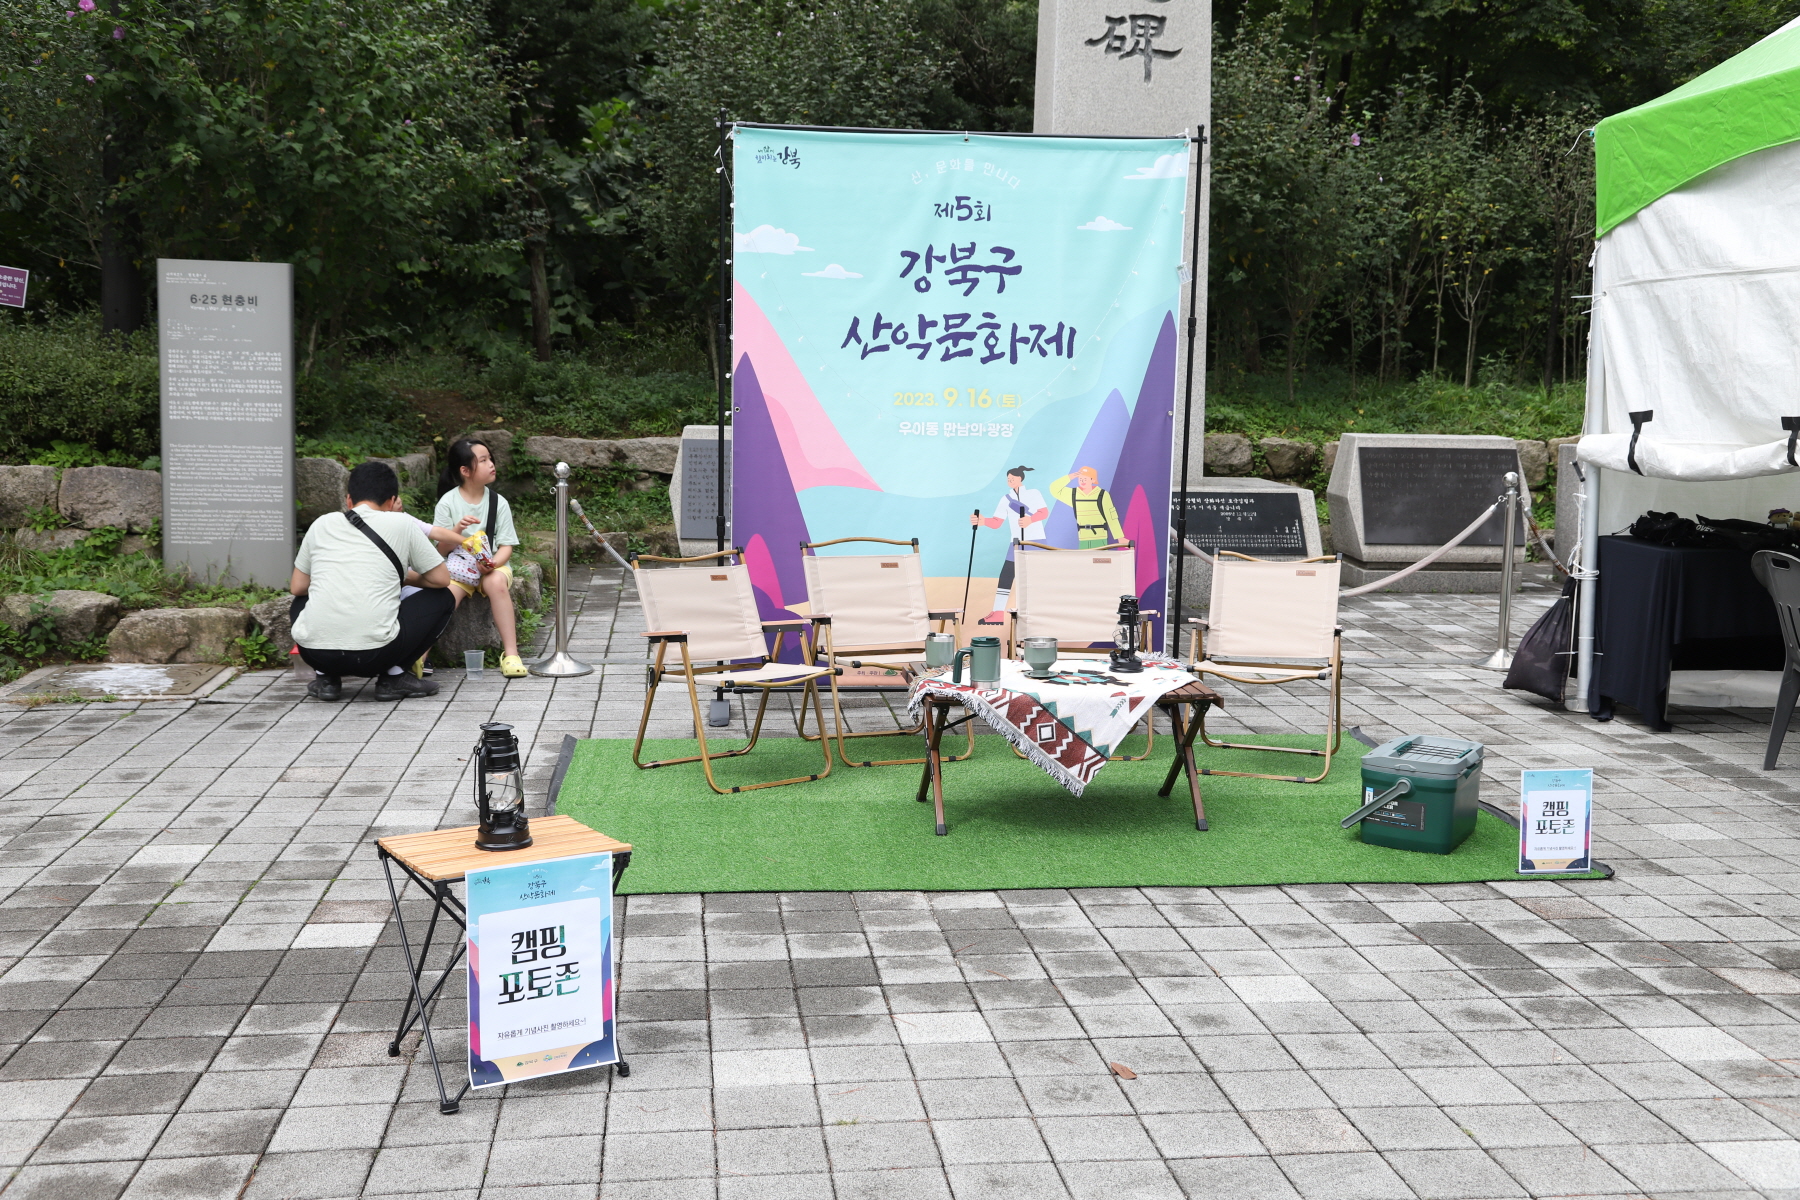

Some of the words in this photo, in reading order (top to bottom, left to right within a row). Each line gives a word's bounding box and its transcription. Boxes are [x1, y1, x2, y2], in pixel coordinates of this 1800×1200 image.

[1084, 14, 1183, 84] 碑
[777, 145, 801, 170] 강북
[936, 158, 975, 174] 문화를
[983, 162, 1021, 189] 만나다
[933, 195, 991, 221] 제5회
[900, 241, 1023, 297] 강북구
[221, 294, 259, 307] 현충비
[841, 311, 1077, 365] 산악문화제
[893, 391, 939, 408] 2023.
[996, 393, 1022, 409] (토)
[898, 421, 940, 436] 우이동
[943, 421, 983, 437] 만남의
[987, 422, 1015, 438] 광장
[1541, 800, 1570, 817] 캠핑
[1534, 818, 1576, 835] 포토존
[511, 924, 567, 965] 캠핑
[497, 961, 581, 1006] 포토존
[497, 1028, 523, 1040] 자유롭게
[525, 1024, 549, 1036] 기념사진
